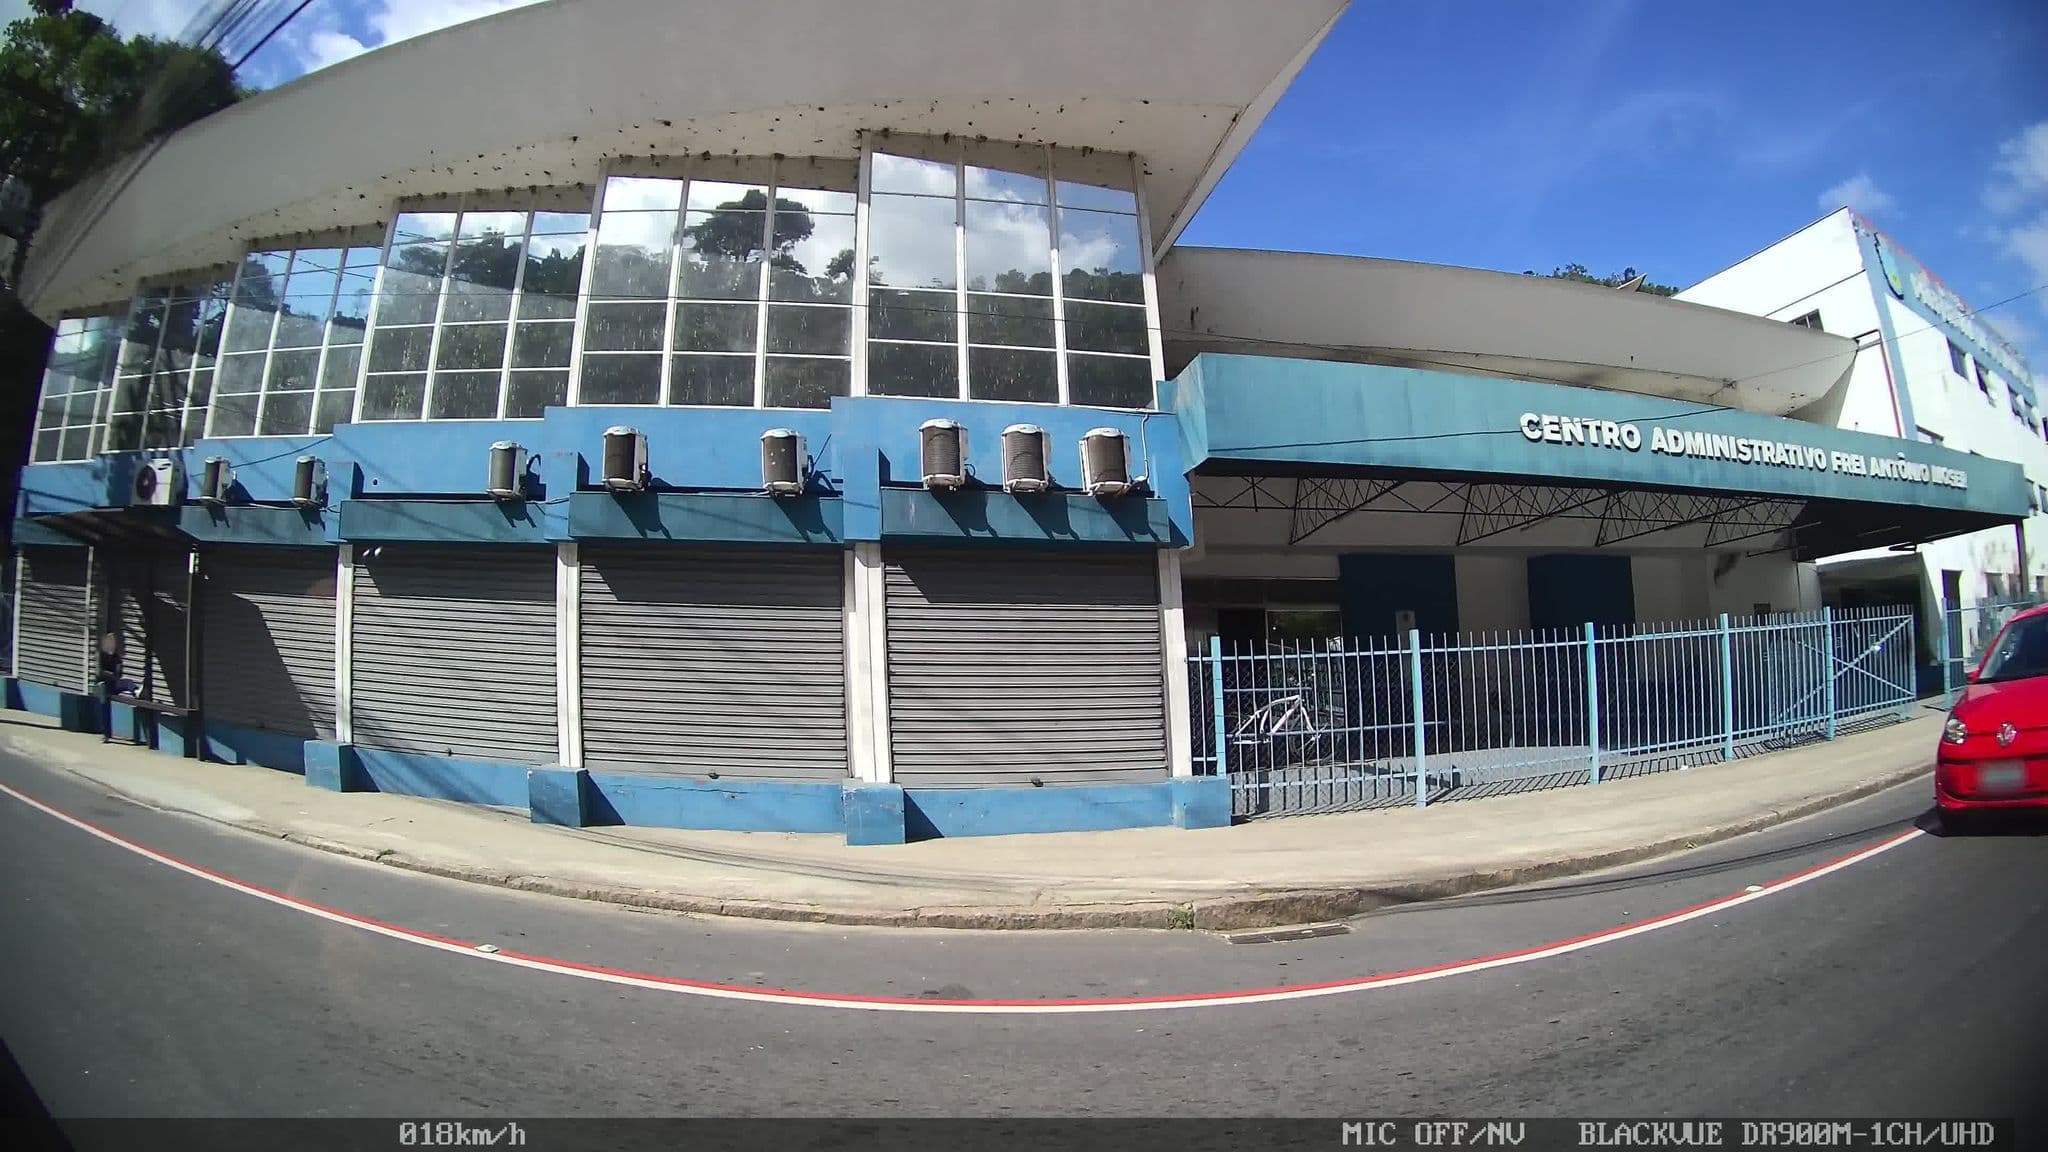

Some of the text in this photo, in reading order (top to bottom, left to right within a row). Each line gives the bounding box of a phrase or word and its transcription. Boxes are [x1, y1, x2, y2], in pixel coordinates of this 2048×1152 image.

[1520, 412, 1642, 450] CENTRO
[1651, 426, 1827, 470] ADMINISTRATIVO
[1831, 450, 1867, 476] FREI
